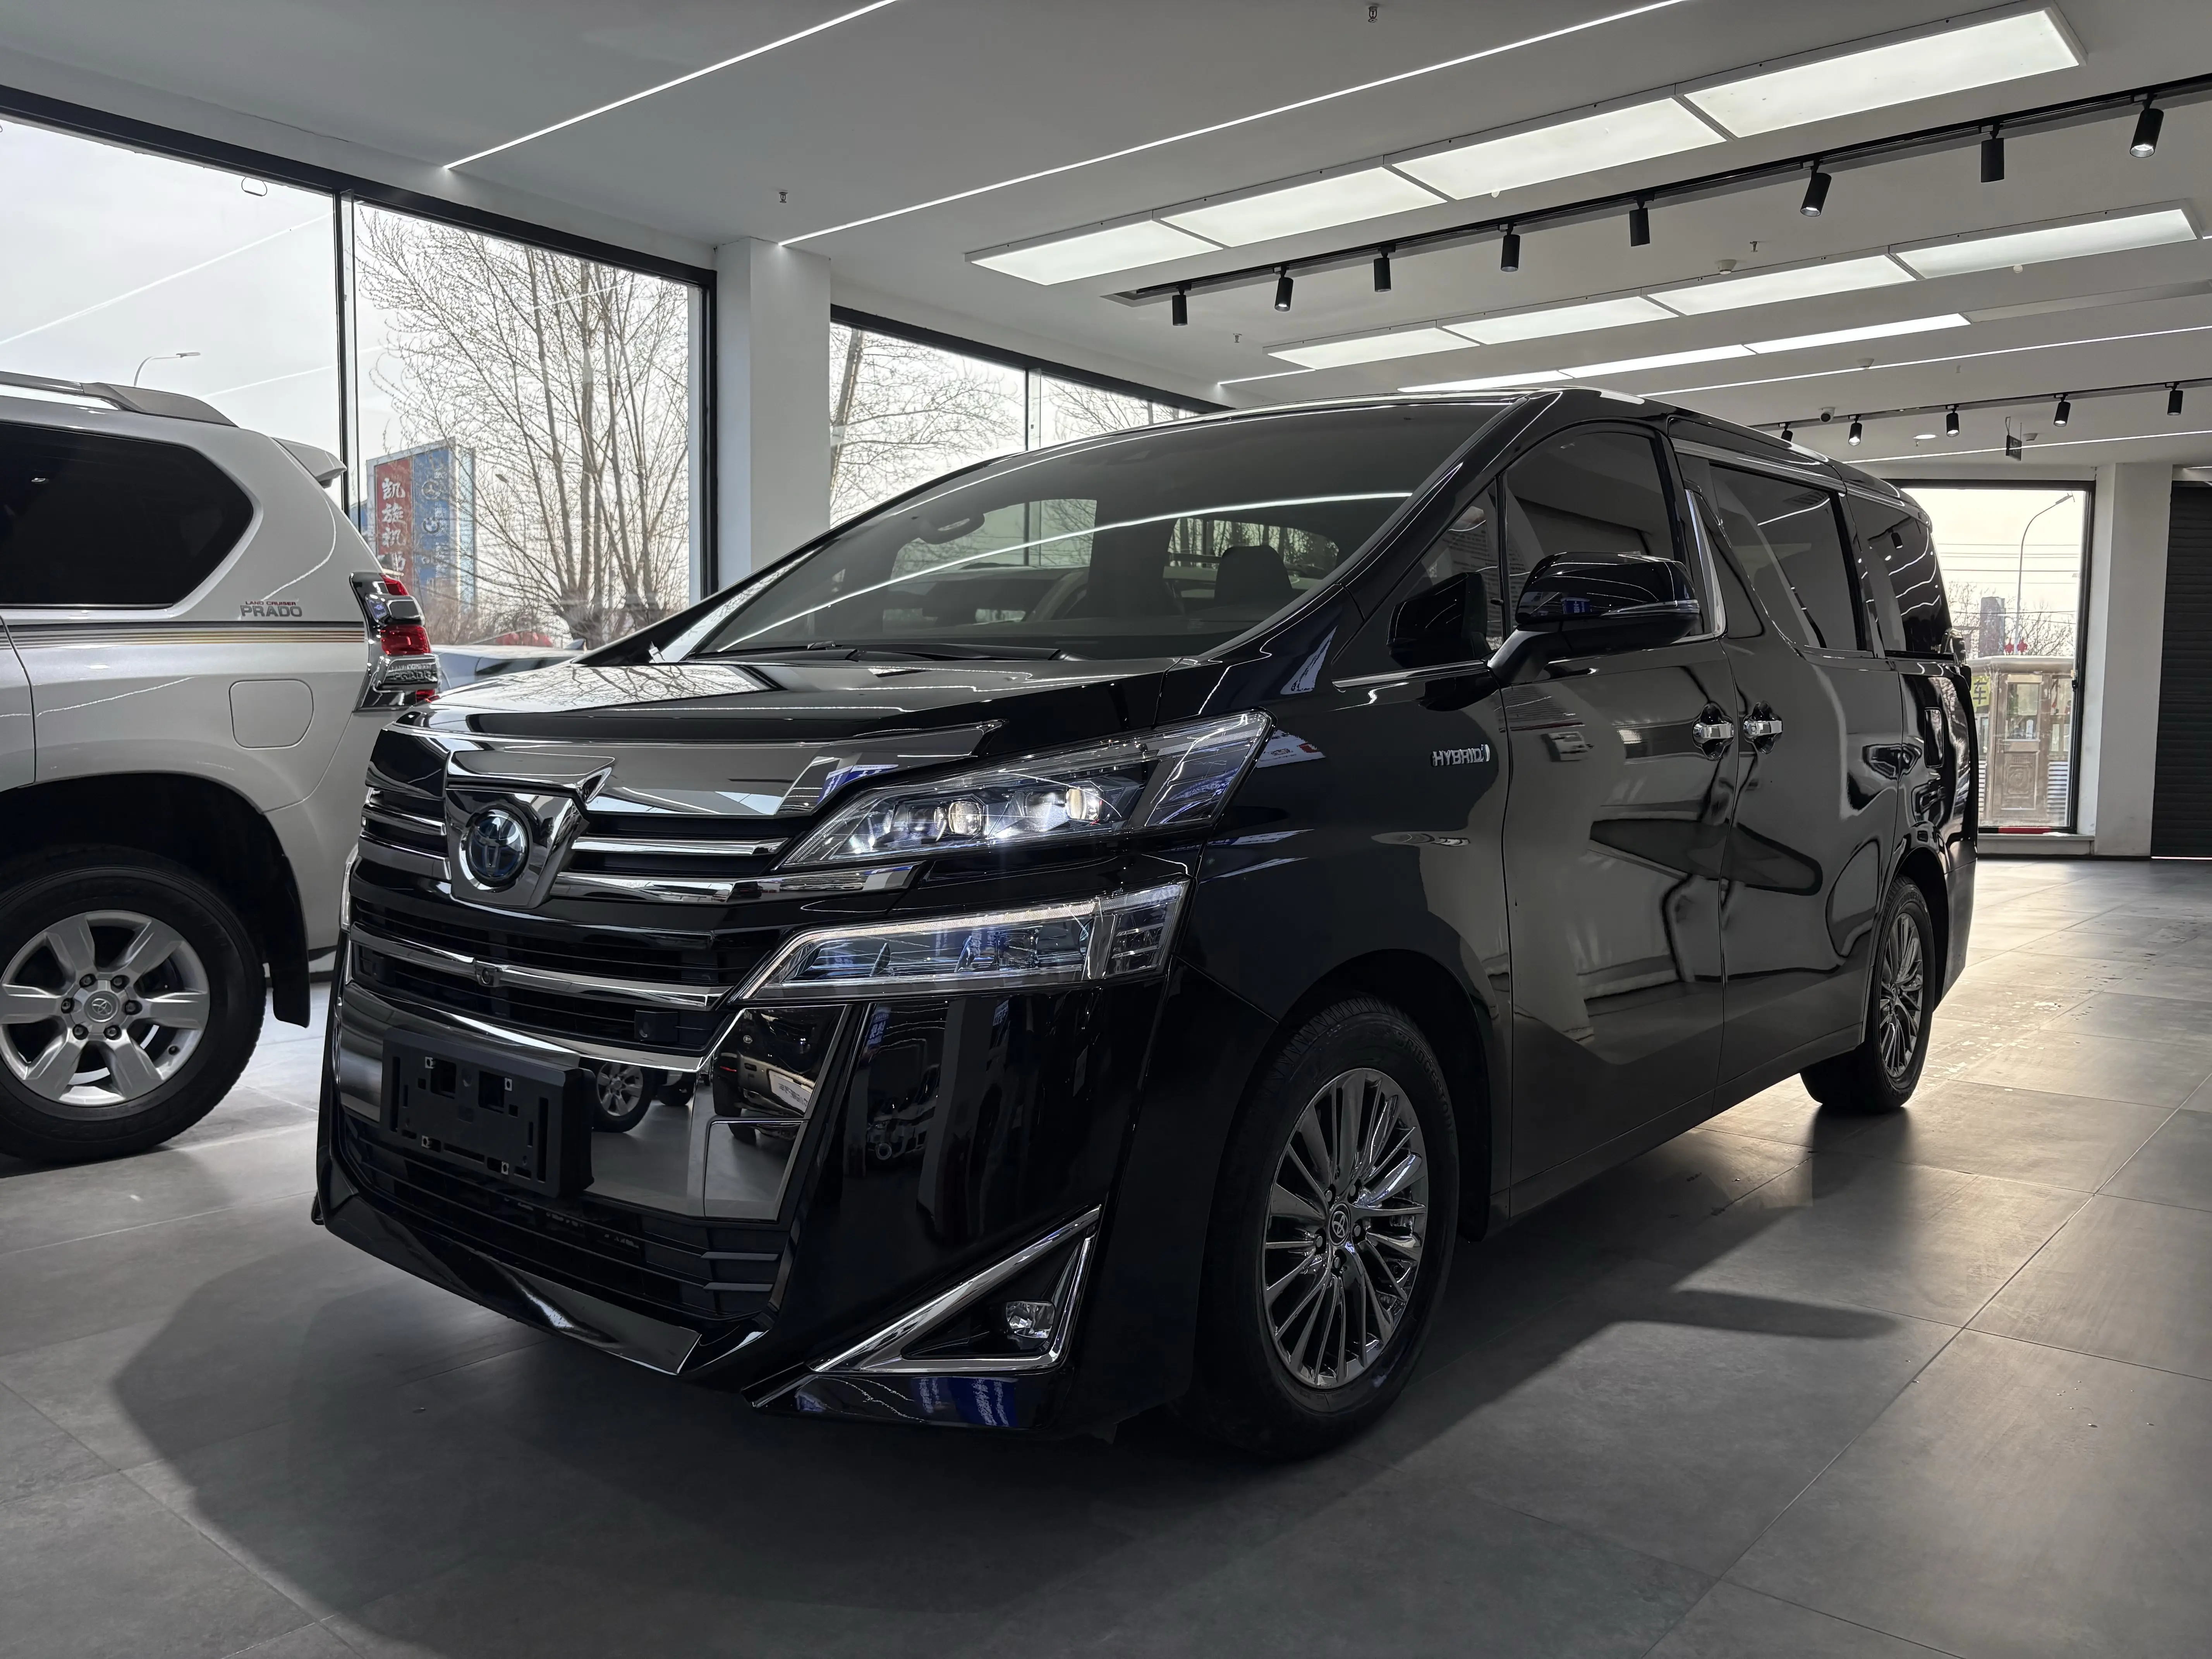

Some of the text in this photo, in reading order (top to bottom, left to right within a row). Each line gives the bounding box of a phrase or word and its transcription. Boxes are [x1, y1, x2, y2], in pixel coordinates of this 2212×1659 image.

[240, 605, 302, 617] PRADO
[1972, 679, 1988, 705] 车
[1432, 748, 1484, 766] HYBRID
